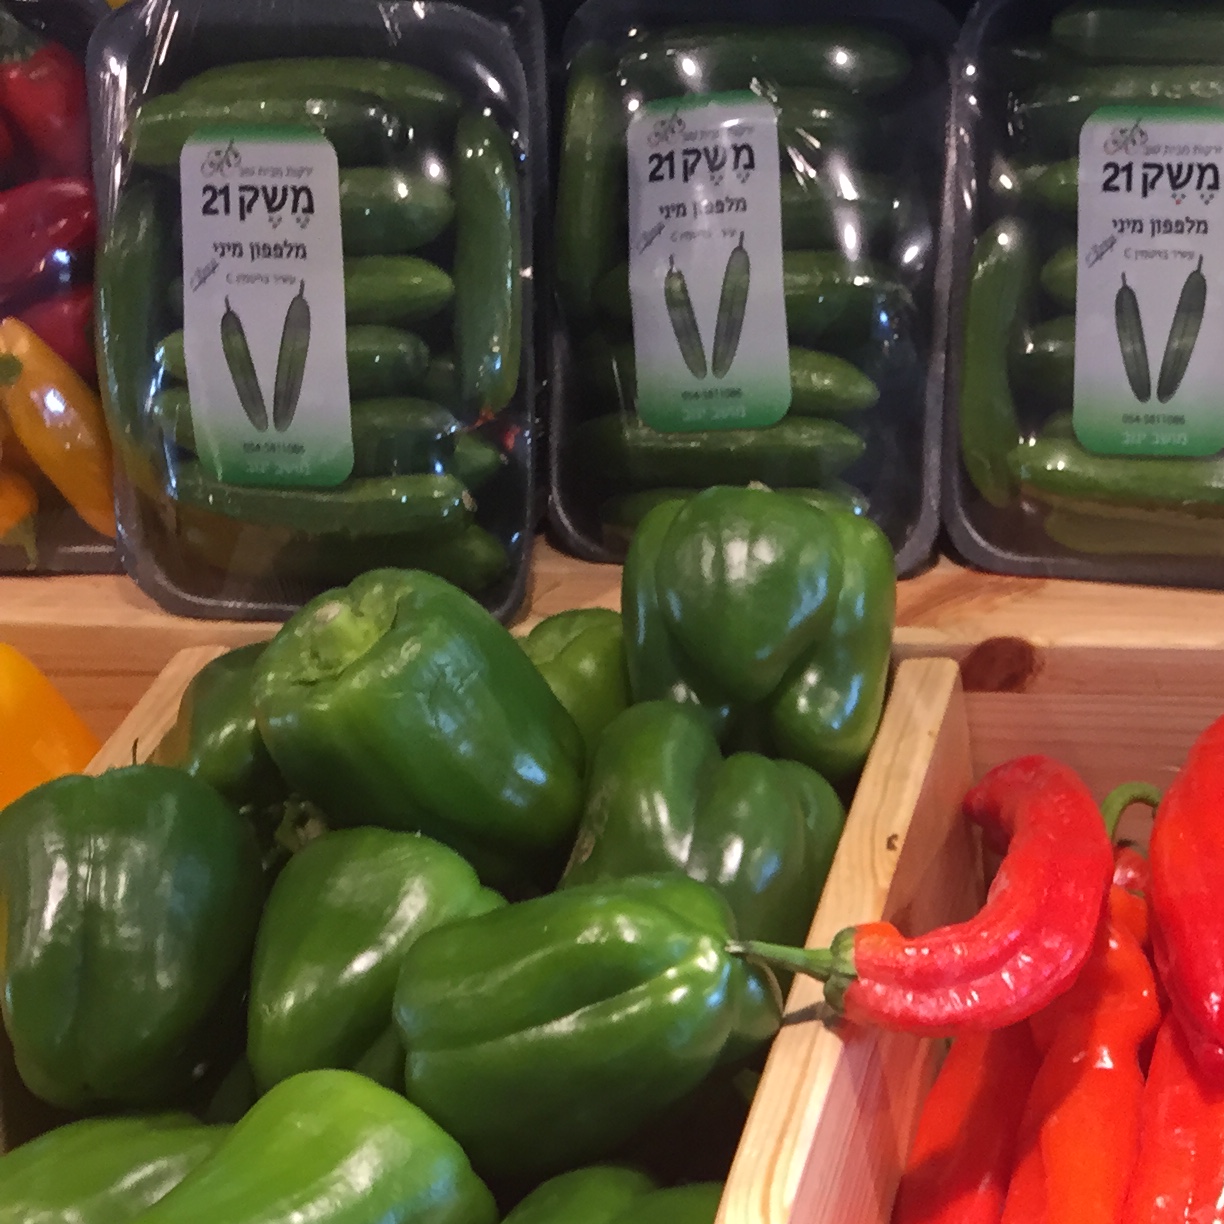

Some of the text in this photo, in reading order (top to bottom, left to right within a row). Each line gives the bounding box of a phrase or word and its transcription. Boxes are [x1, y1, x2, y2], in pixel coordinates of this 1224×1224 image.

[648, 149, 675, 182] 21
[1102, 161, 1133, 192] 21
[202, 184, 231, 216] 21
[659, 195, 747, 221] מלפפן מיני
[1112, 216, 1208, 237] מלפפון מיני
[213, 239, 307, 262] מלפפון מיני
